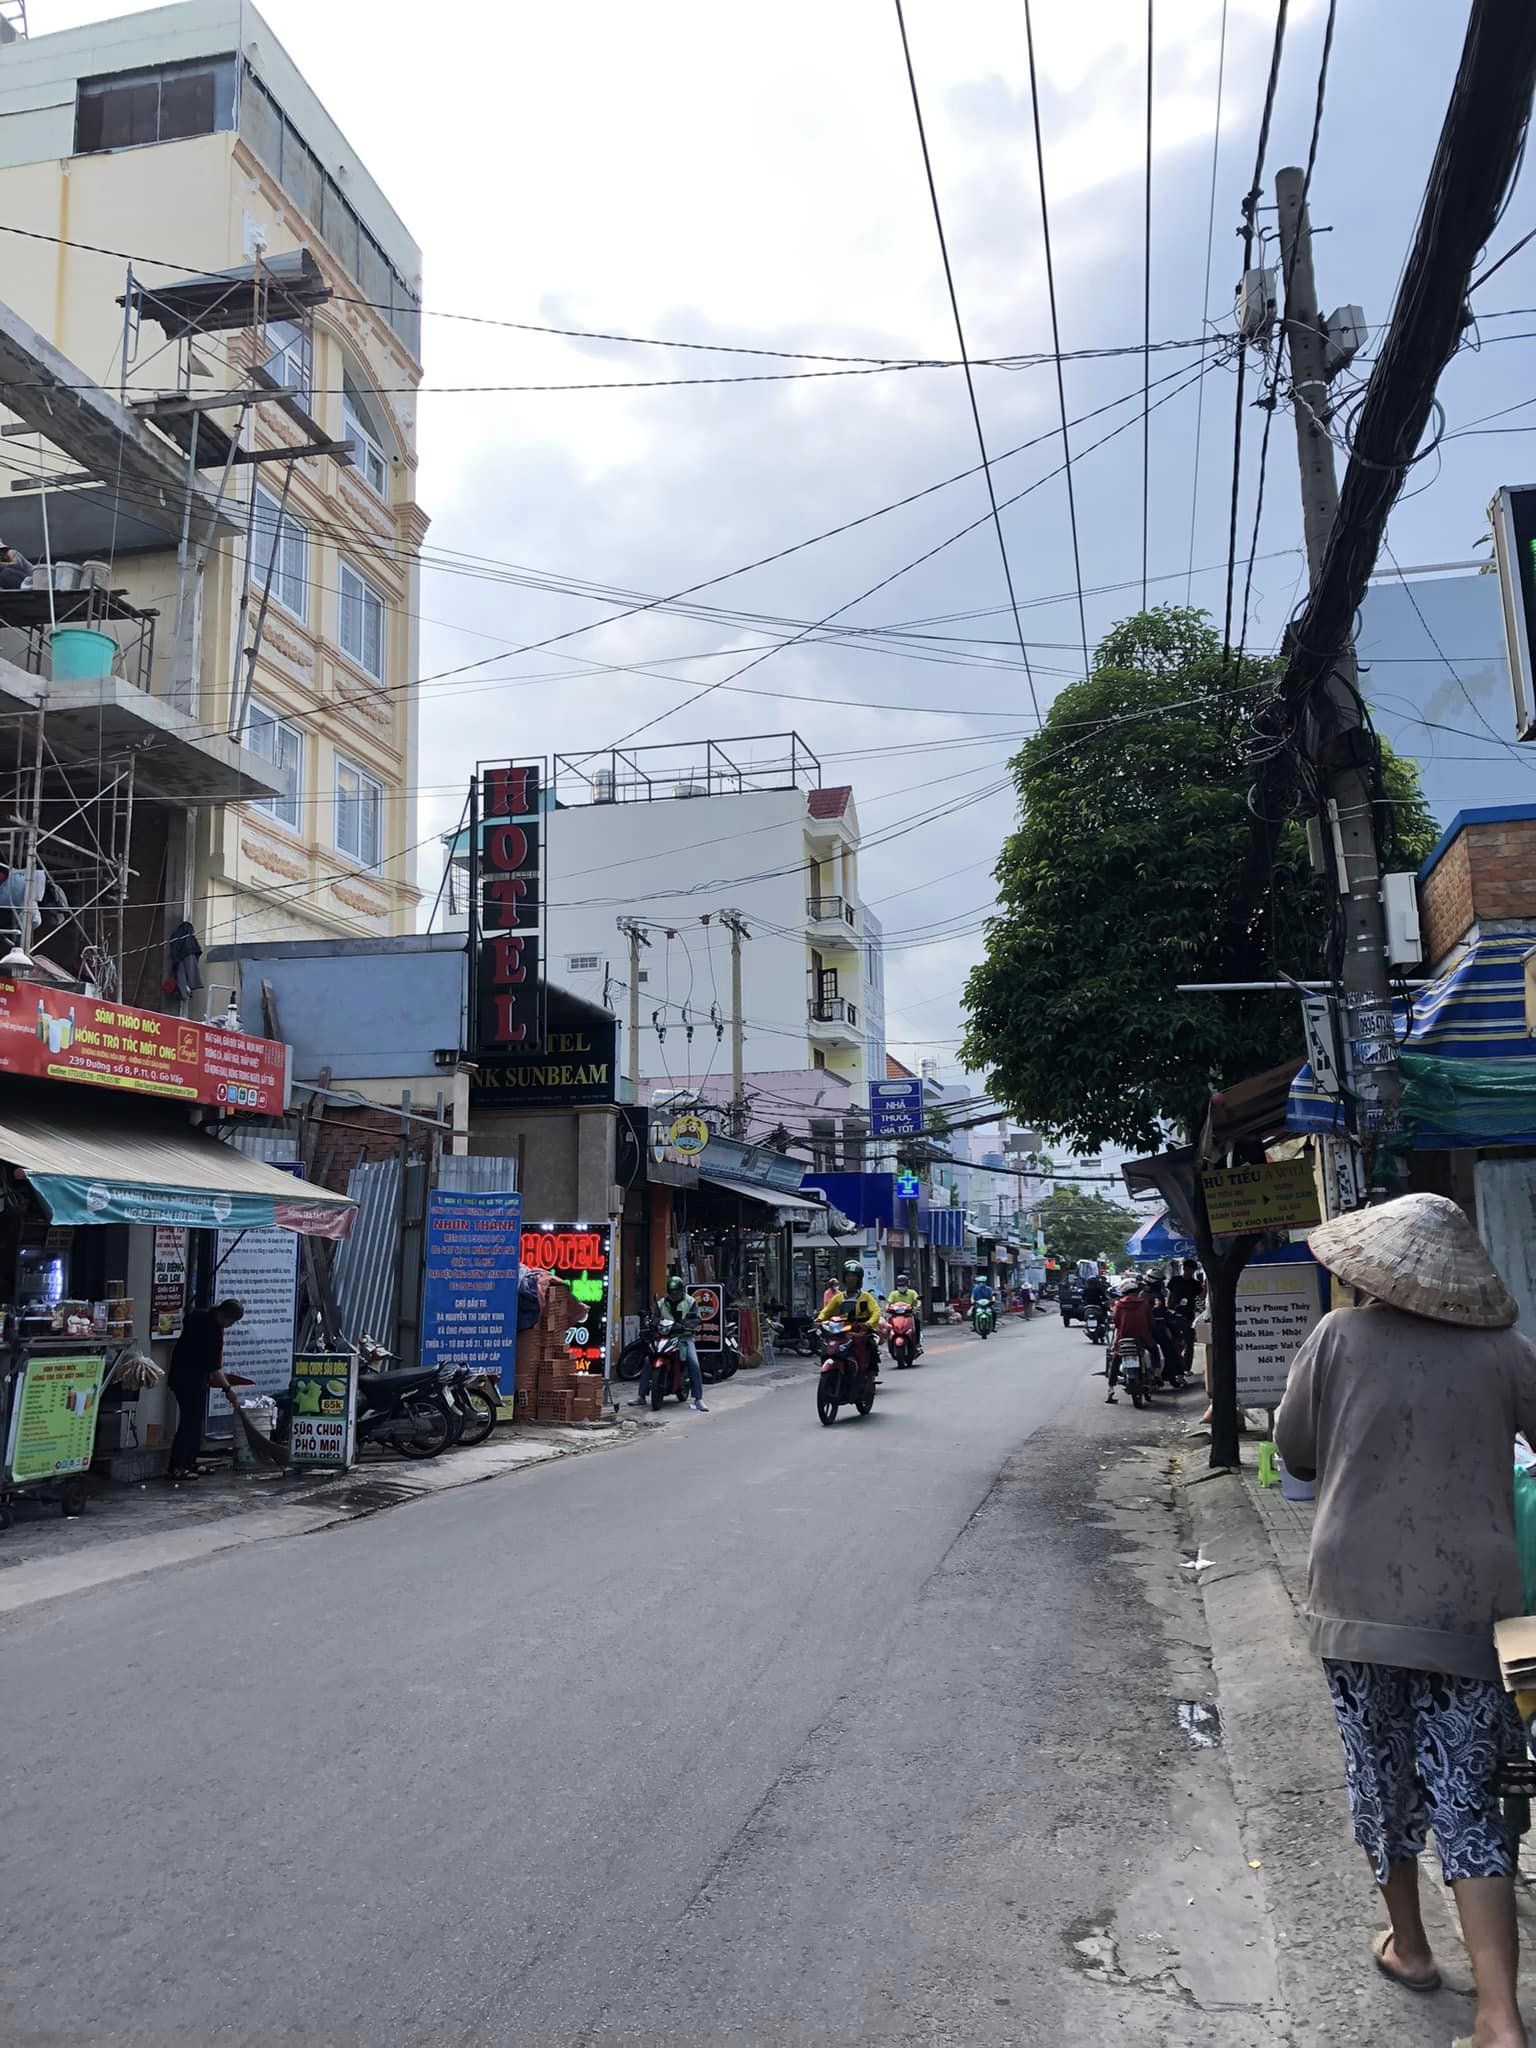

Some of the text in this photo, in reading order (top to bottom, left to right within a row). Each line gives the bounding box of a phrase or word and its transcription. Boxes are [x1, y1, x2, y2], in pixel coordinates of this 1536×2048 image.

[491, 768, 529, 1041] HOTEL
[159, 1046, 177, 1060] ONG
[68, 1055, 85, 1066] 239
[505, 1064, 609, 1088] SUNBEAM
[520, 1233, 605, 1270] HOTEL
[1246, 1343, 1277, 1352] Massage
[324, 1400, 341, 1408] 65k
[316, 1423, 342, 1436] CHUA
[320, 1440, 340, 1451] MAI
